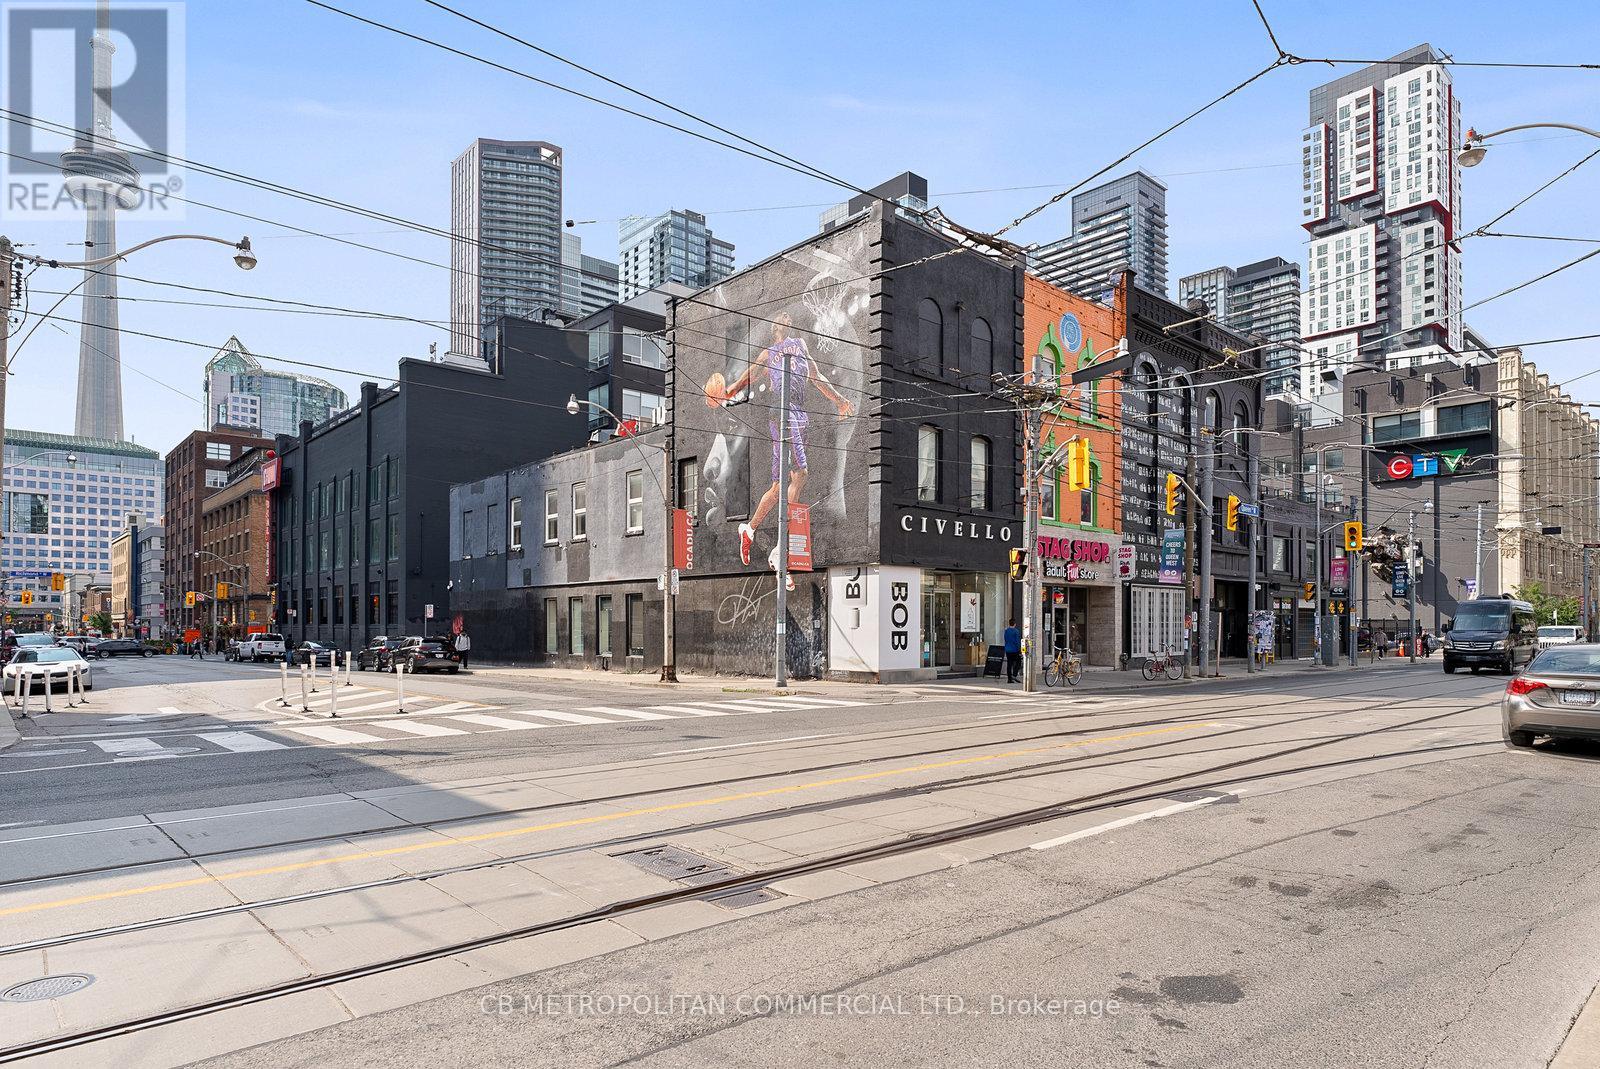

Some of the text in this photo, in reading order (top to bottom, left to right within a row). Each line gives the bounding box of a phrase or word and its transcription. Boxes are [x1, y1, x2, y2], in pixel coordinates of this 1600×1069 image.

[1389, 453, 1463, 476] CTV
[901, 515, 1011, 541] CIVELLO
[1037, 536, 1070, 560] STAG
[1046, 566, 1066, 577] adult
[1080, 568, 1099, 579] store
[891, 582, 908, 650] BOB
